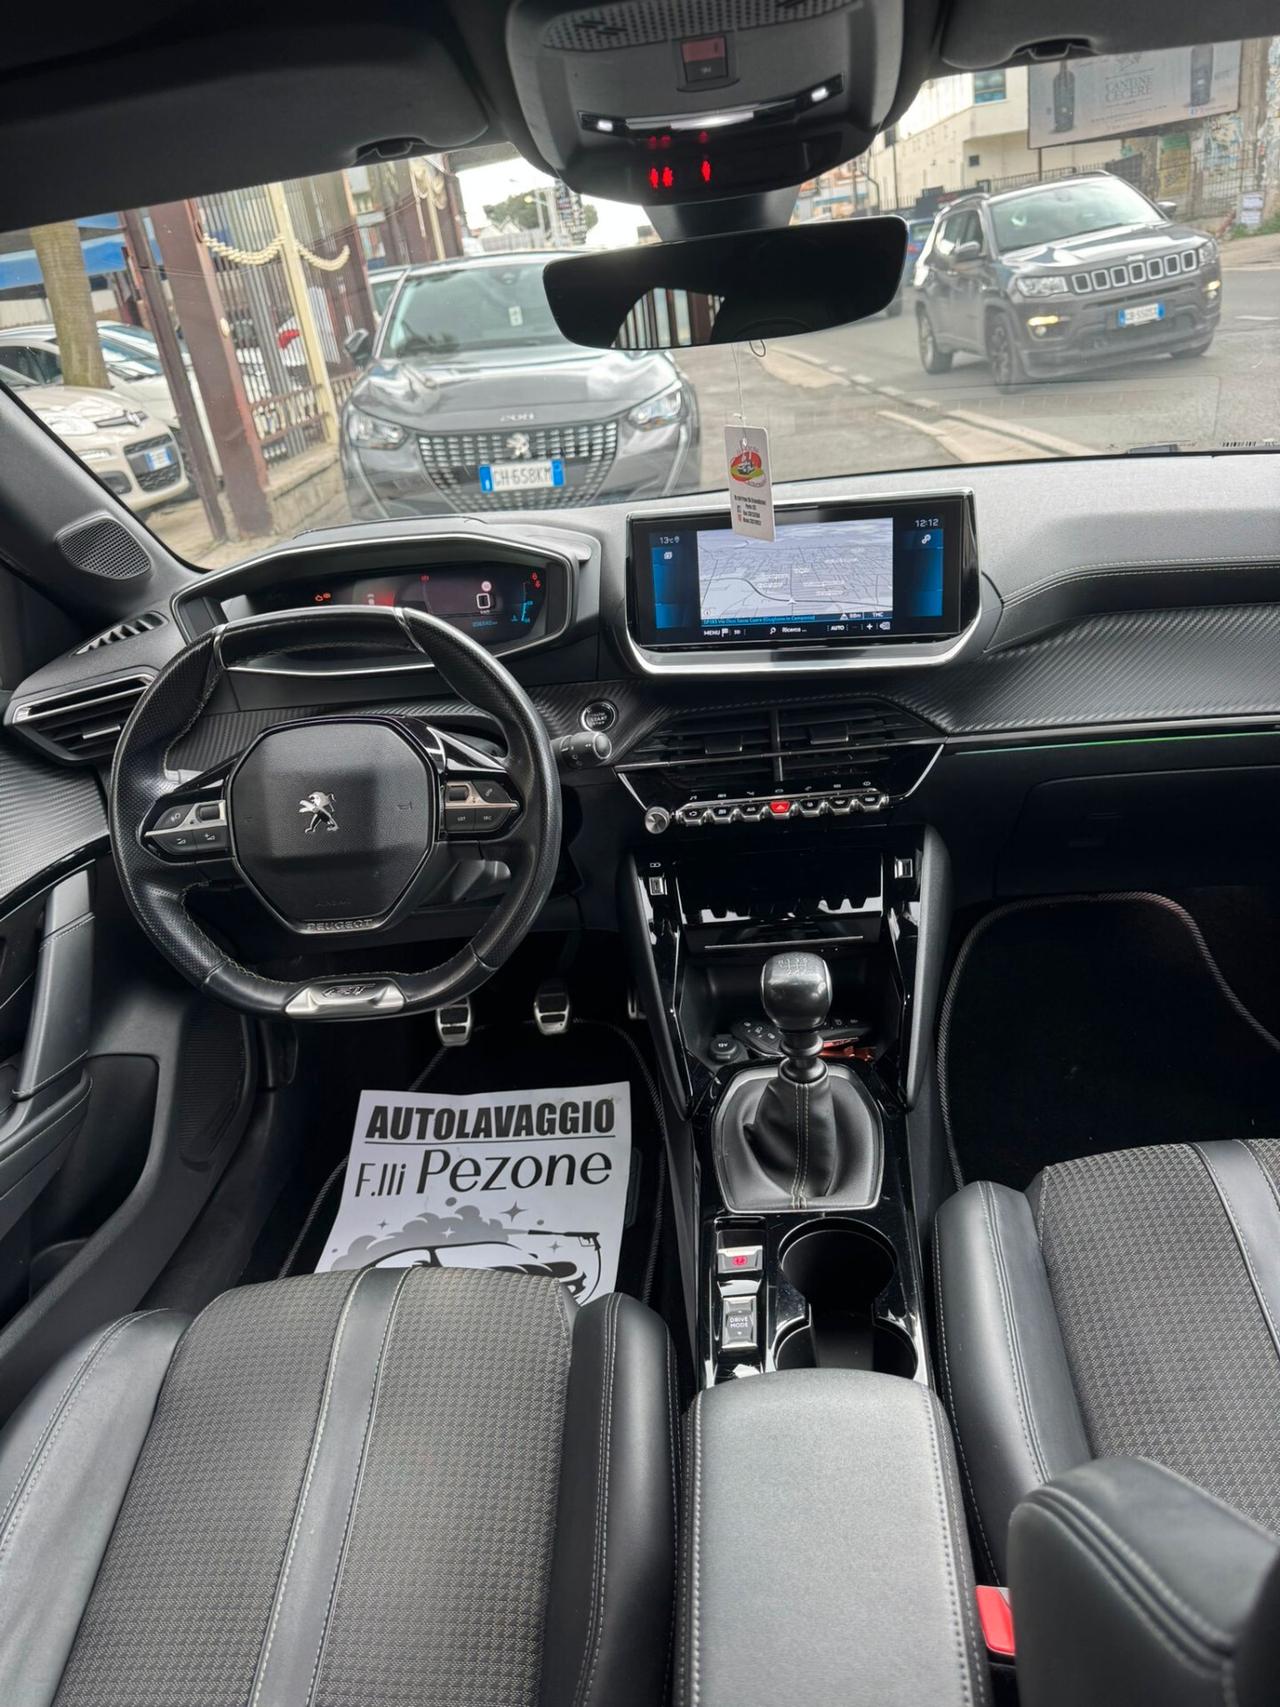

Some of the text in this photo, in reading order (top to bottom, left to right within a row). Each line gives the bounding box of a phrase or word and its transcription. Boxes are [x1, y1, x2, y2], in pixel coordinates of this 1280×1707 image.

[915, 518, 939, 528] 12:12
[703, 628, 721, 636] MENU
[306, 919, 373, 932] PEUGEOT
[364, 1098, 616, 1140] AUTOLAVAGGIO
[416, 1148, 613, 1194] Pezone
